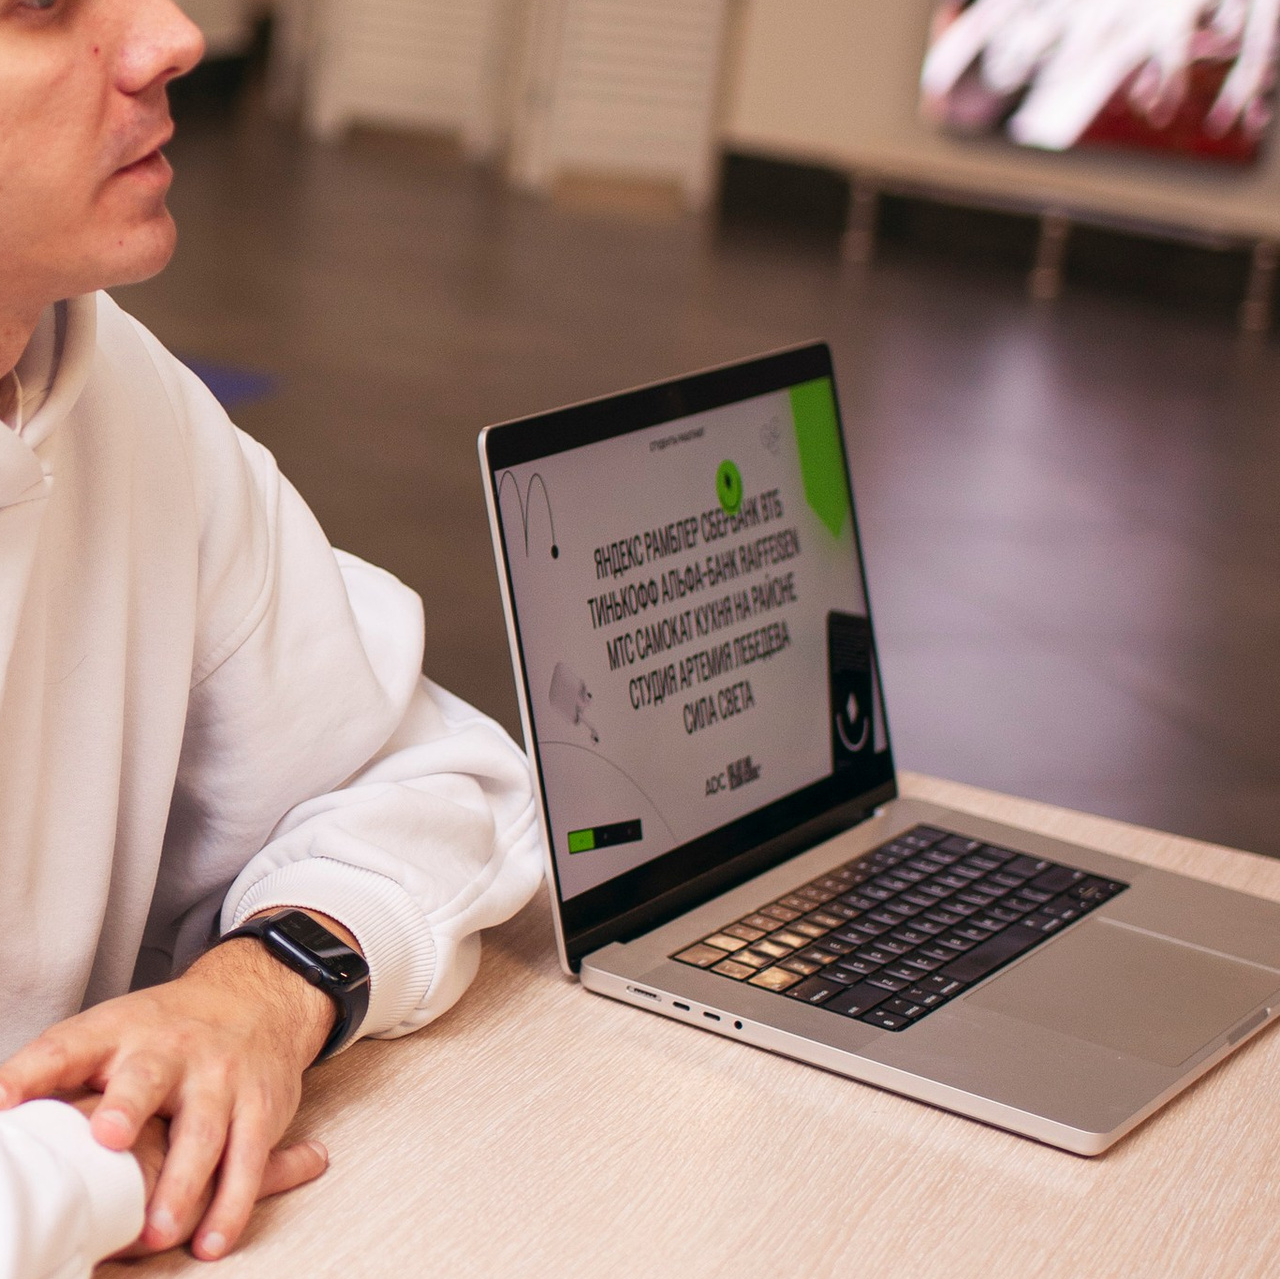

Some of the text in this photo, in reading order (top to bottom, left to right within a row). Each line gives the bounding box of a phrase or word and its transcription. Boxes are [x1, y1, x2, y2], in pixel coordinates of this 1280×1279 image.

[587, 526, 801, 630] ТИНЬКОФФ АЛЬФА-БАНК RAIFFEISEN
[594, 534, 644, 580] ЯНДЕКС
[644, 516, 699, 563] РАМБЛЕР
[760, 488, 785, 523] ВТБ
[606, 571, 797, 671] МТС САМОКАТ КУХНЯ НА РАЙОНЕ
[629, 620, 791, 710] СТУДИЯ АРТЕМИЯ ЛЕБЕДЕВА
[683, 679, 755, 735] СИЛА СВЕТА
